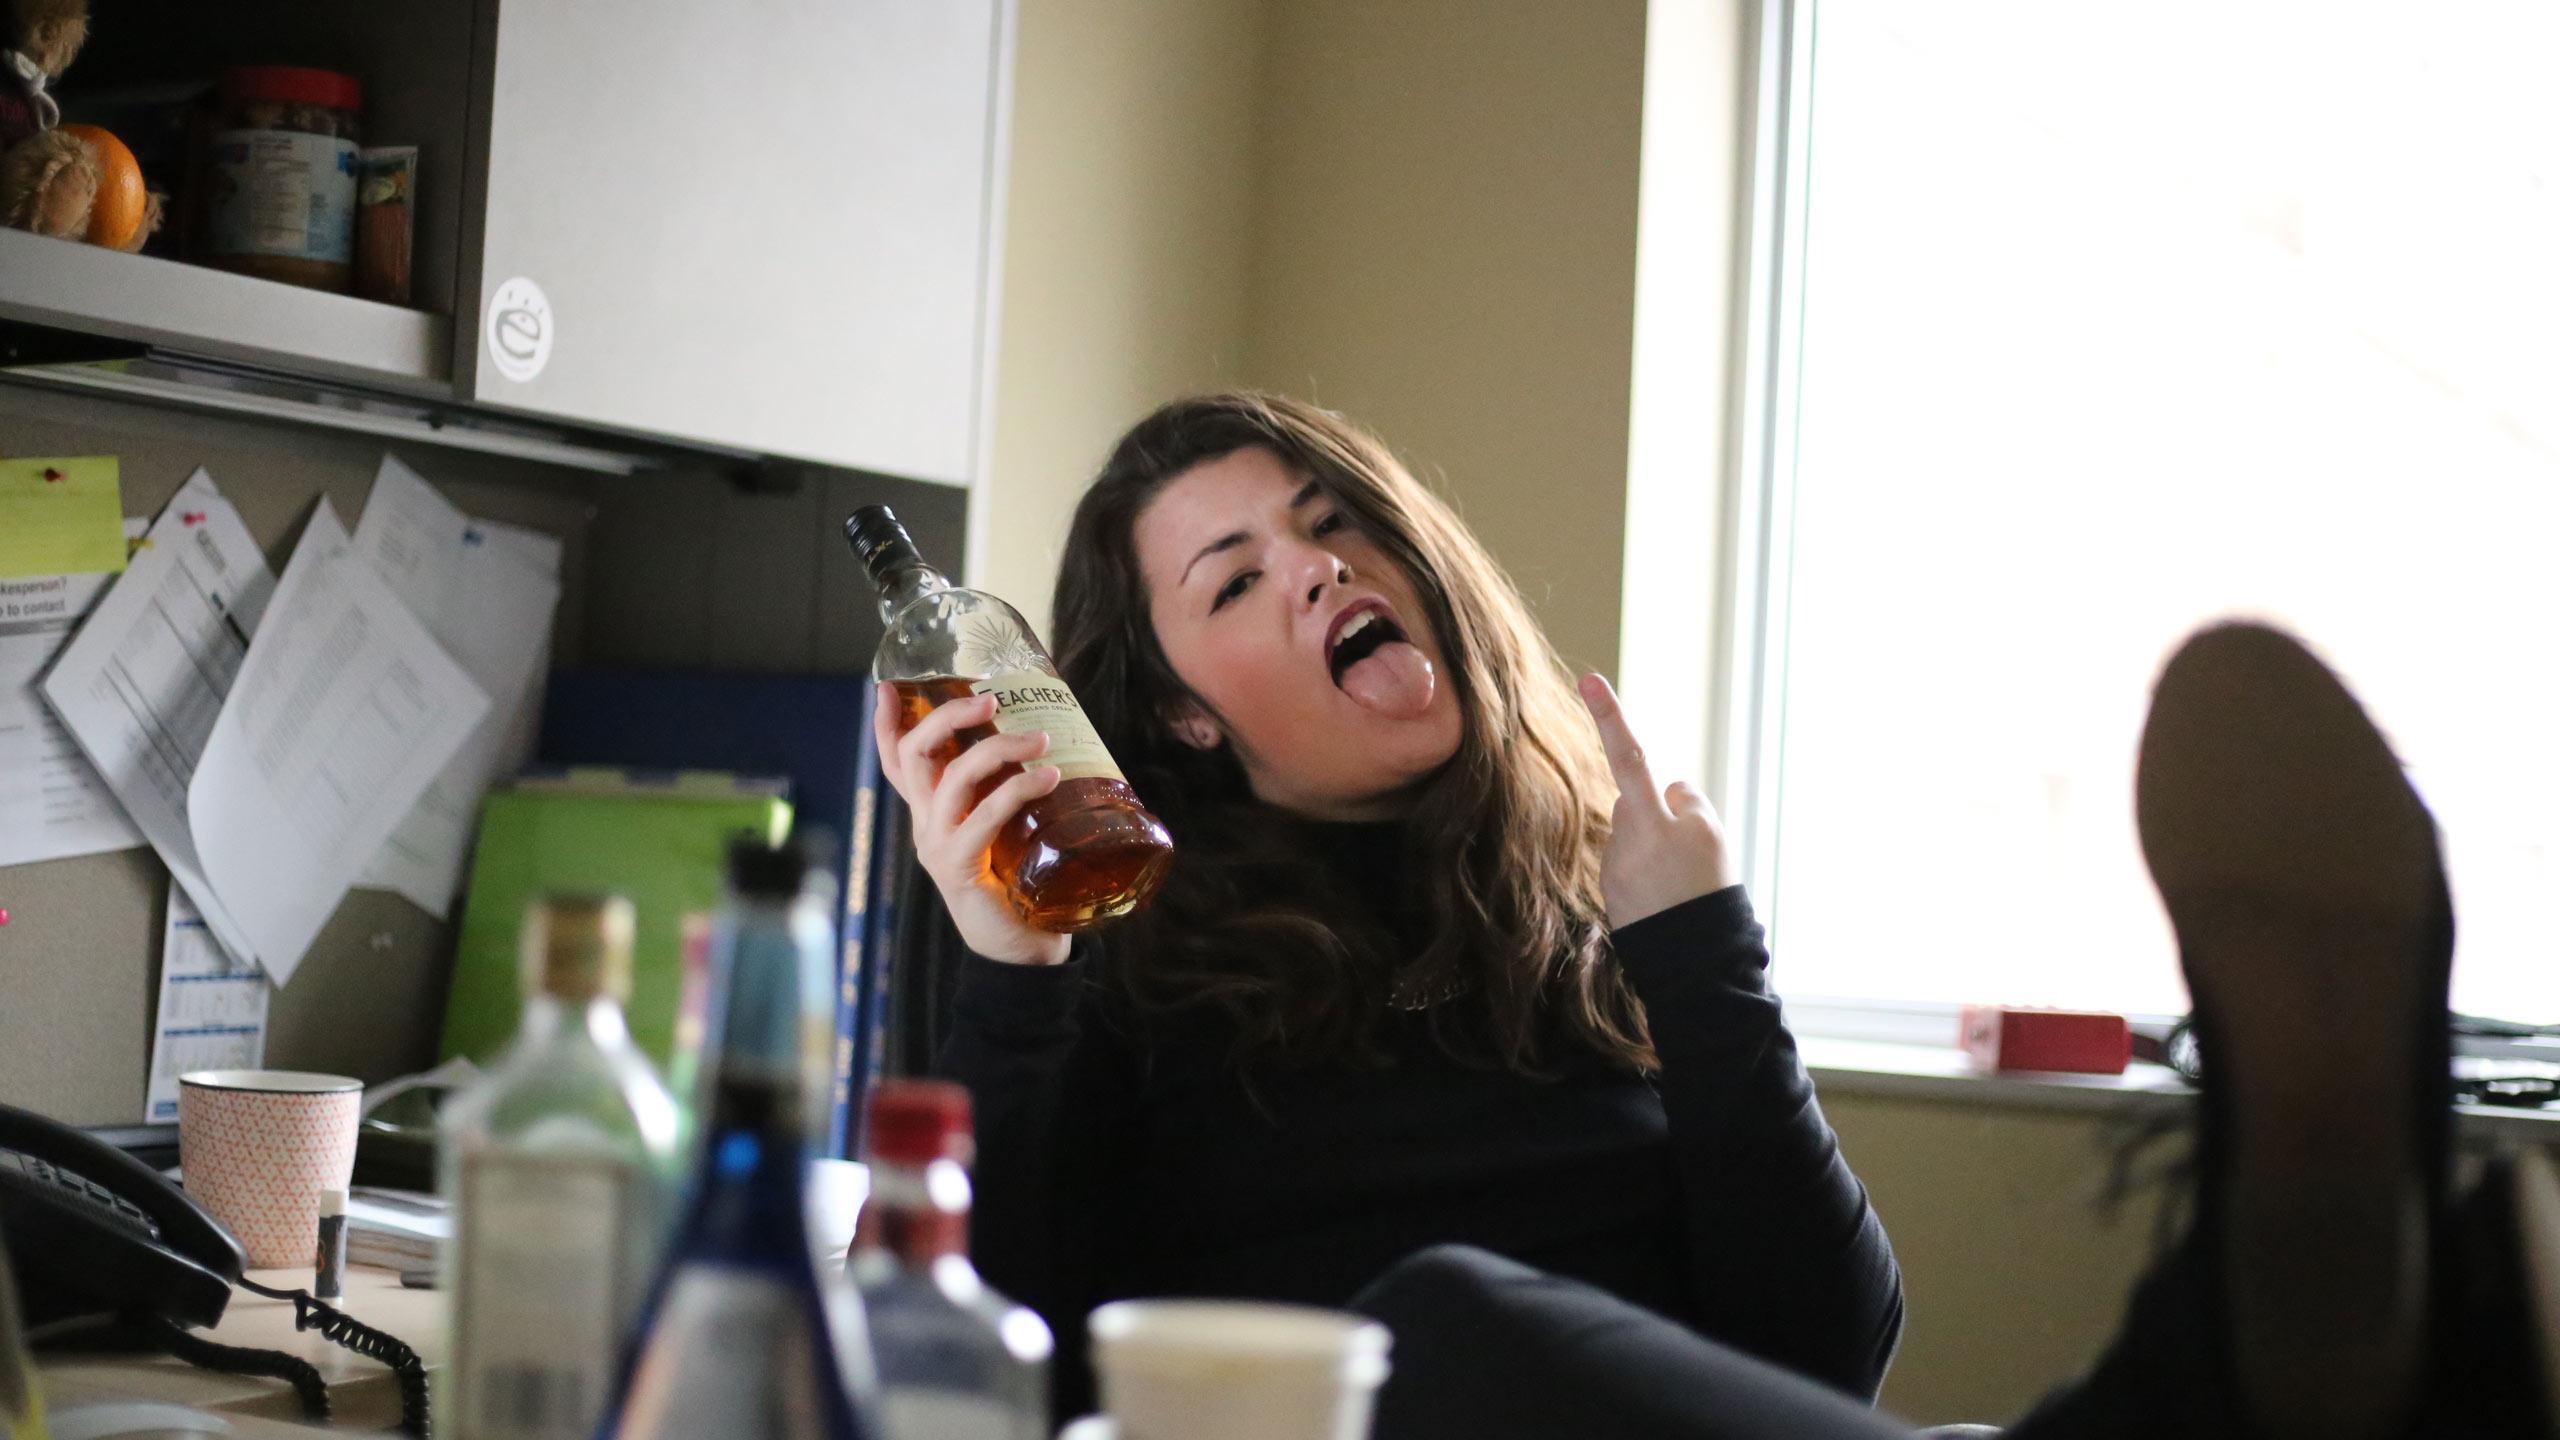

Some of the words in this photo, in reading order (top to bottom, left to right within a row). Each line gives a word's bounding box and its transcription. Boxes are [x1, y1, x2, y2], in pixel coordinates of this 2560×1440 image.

[6, 603, 20, 617] to
[22, 598, 65, 616] contact
[1010, 705, 1050, 714] HIGHLAND
